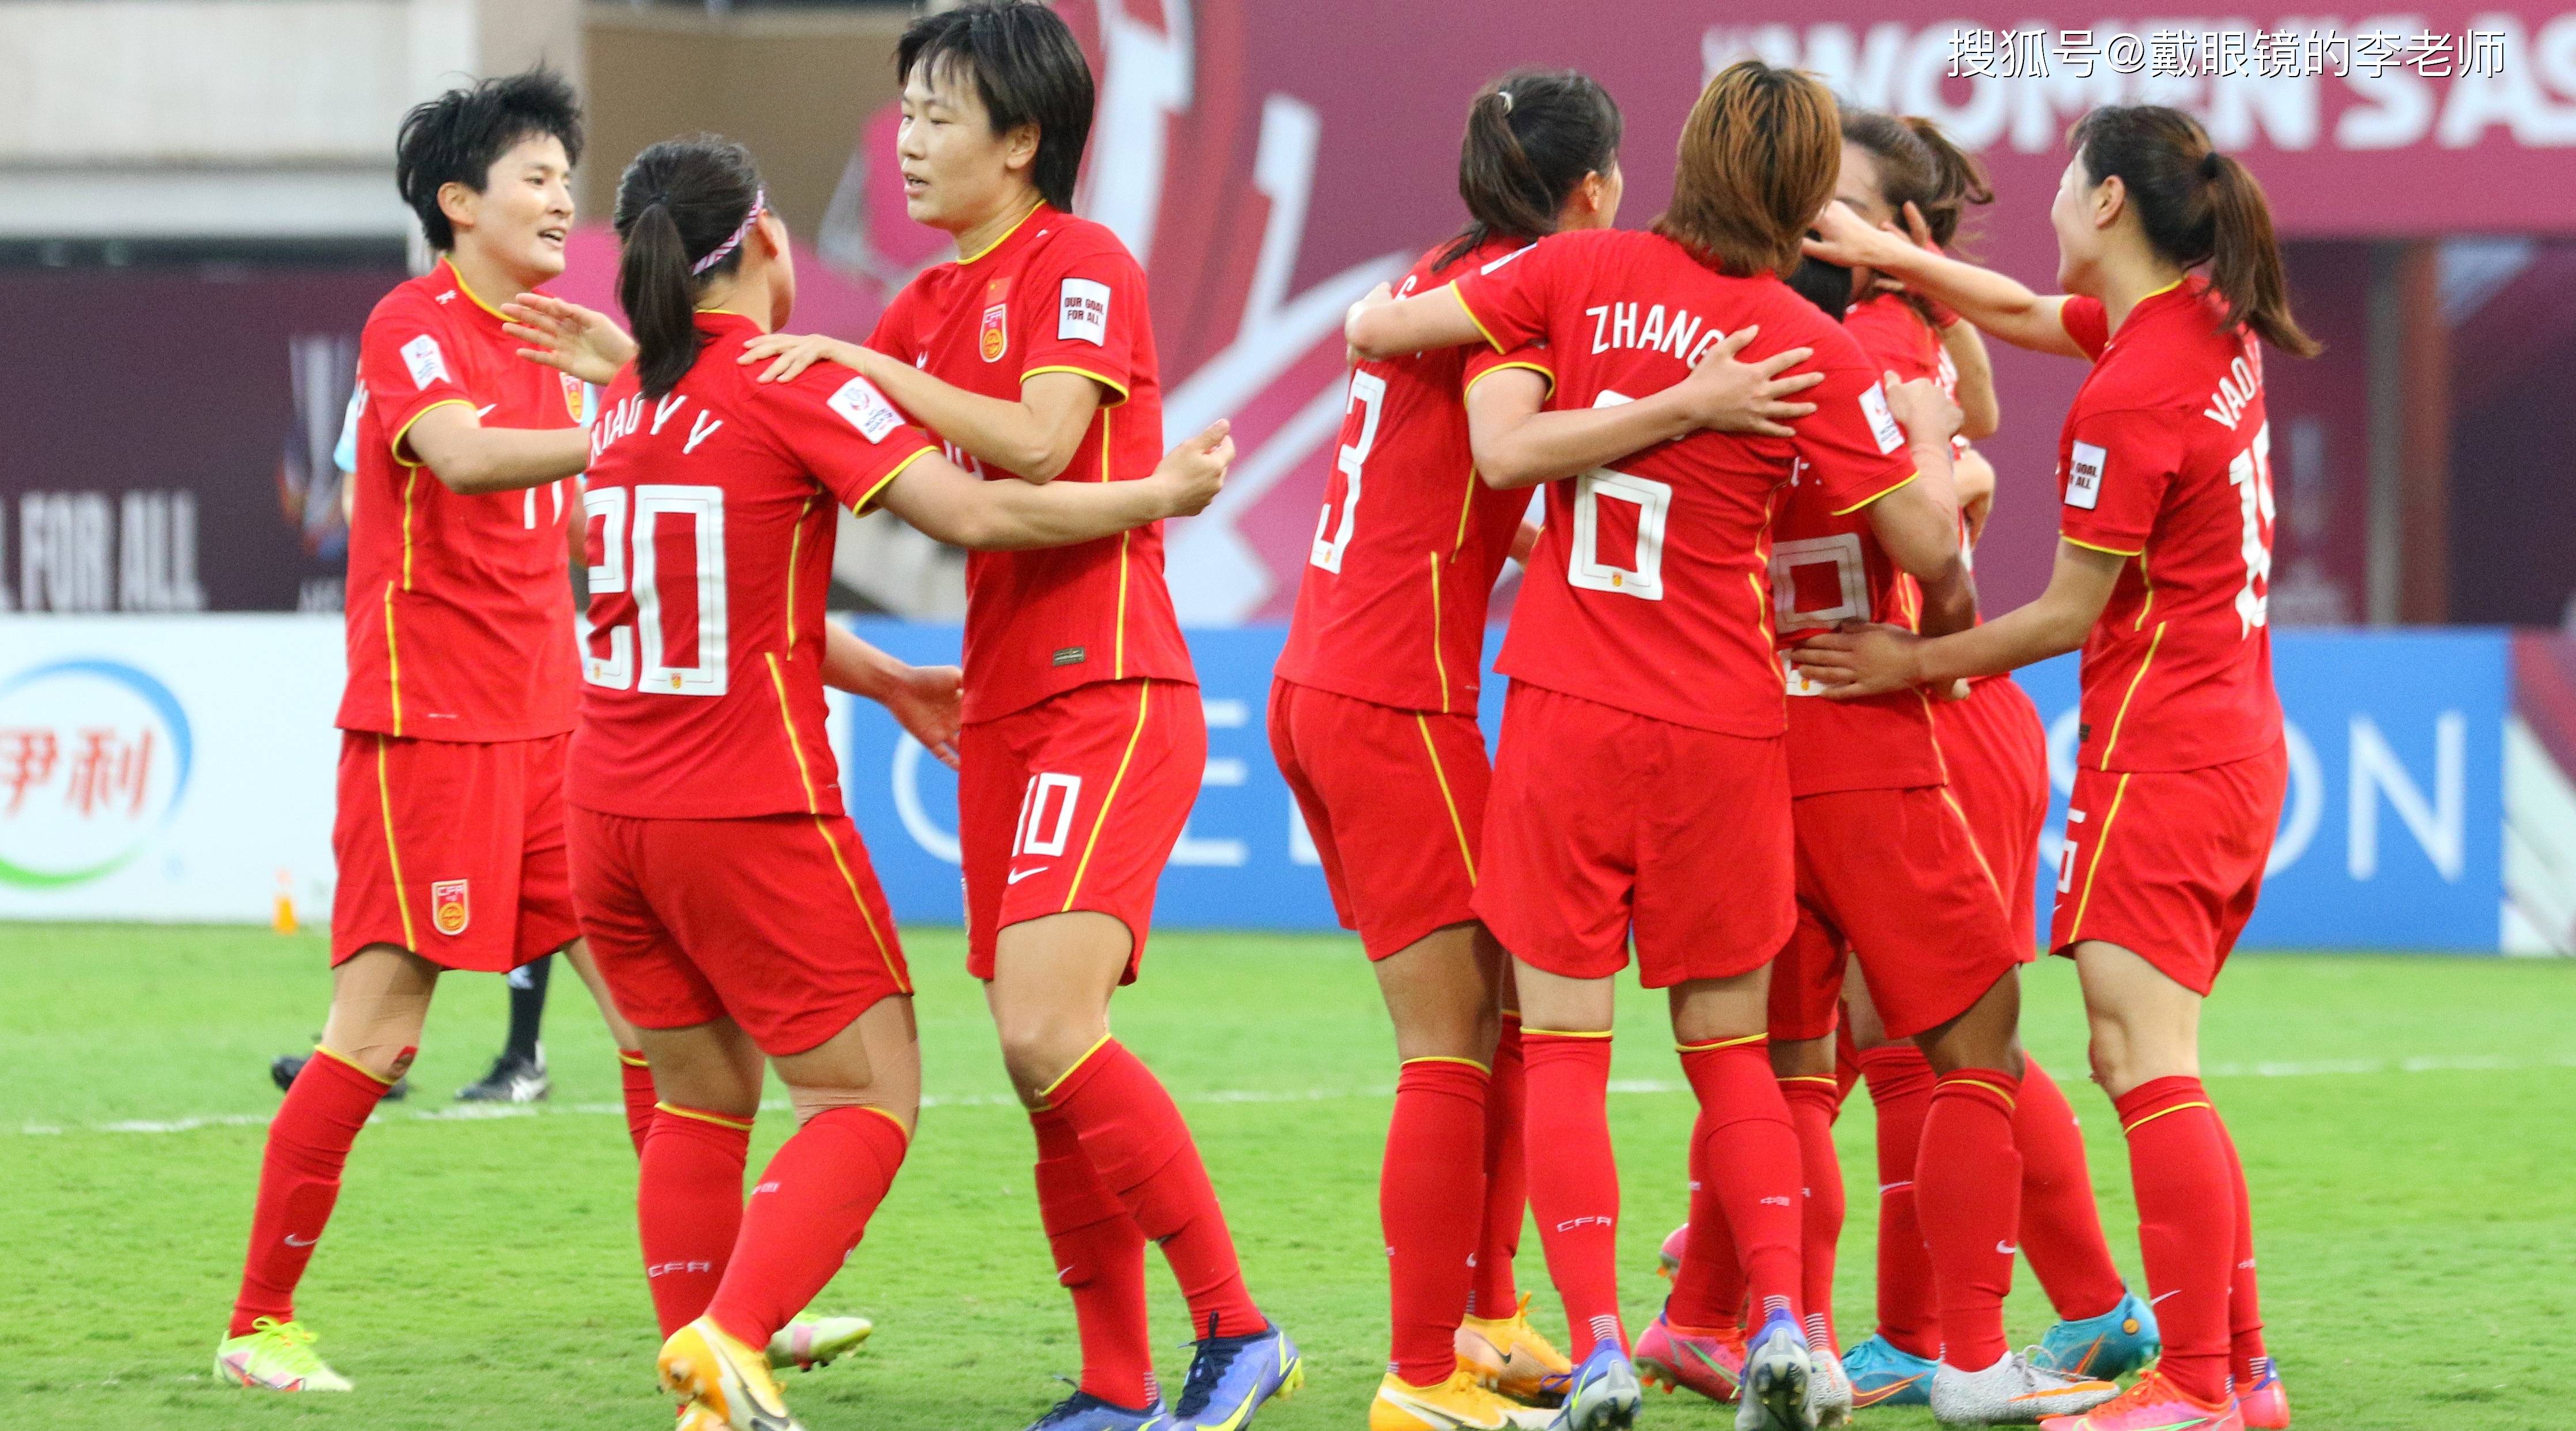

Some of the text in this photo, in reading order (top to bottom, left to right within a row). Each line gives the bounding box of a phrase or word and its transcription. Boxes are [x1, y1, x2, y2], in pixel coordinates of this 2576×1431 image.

[1064, 296, 1082, 308] OUR
[1067, 309, 1099, 325] FOR ALL
[582, 484, 728, 696] 20
[1011, 772, 1082, 858] 10
